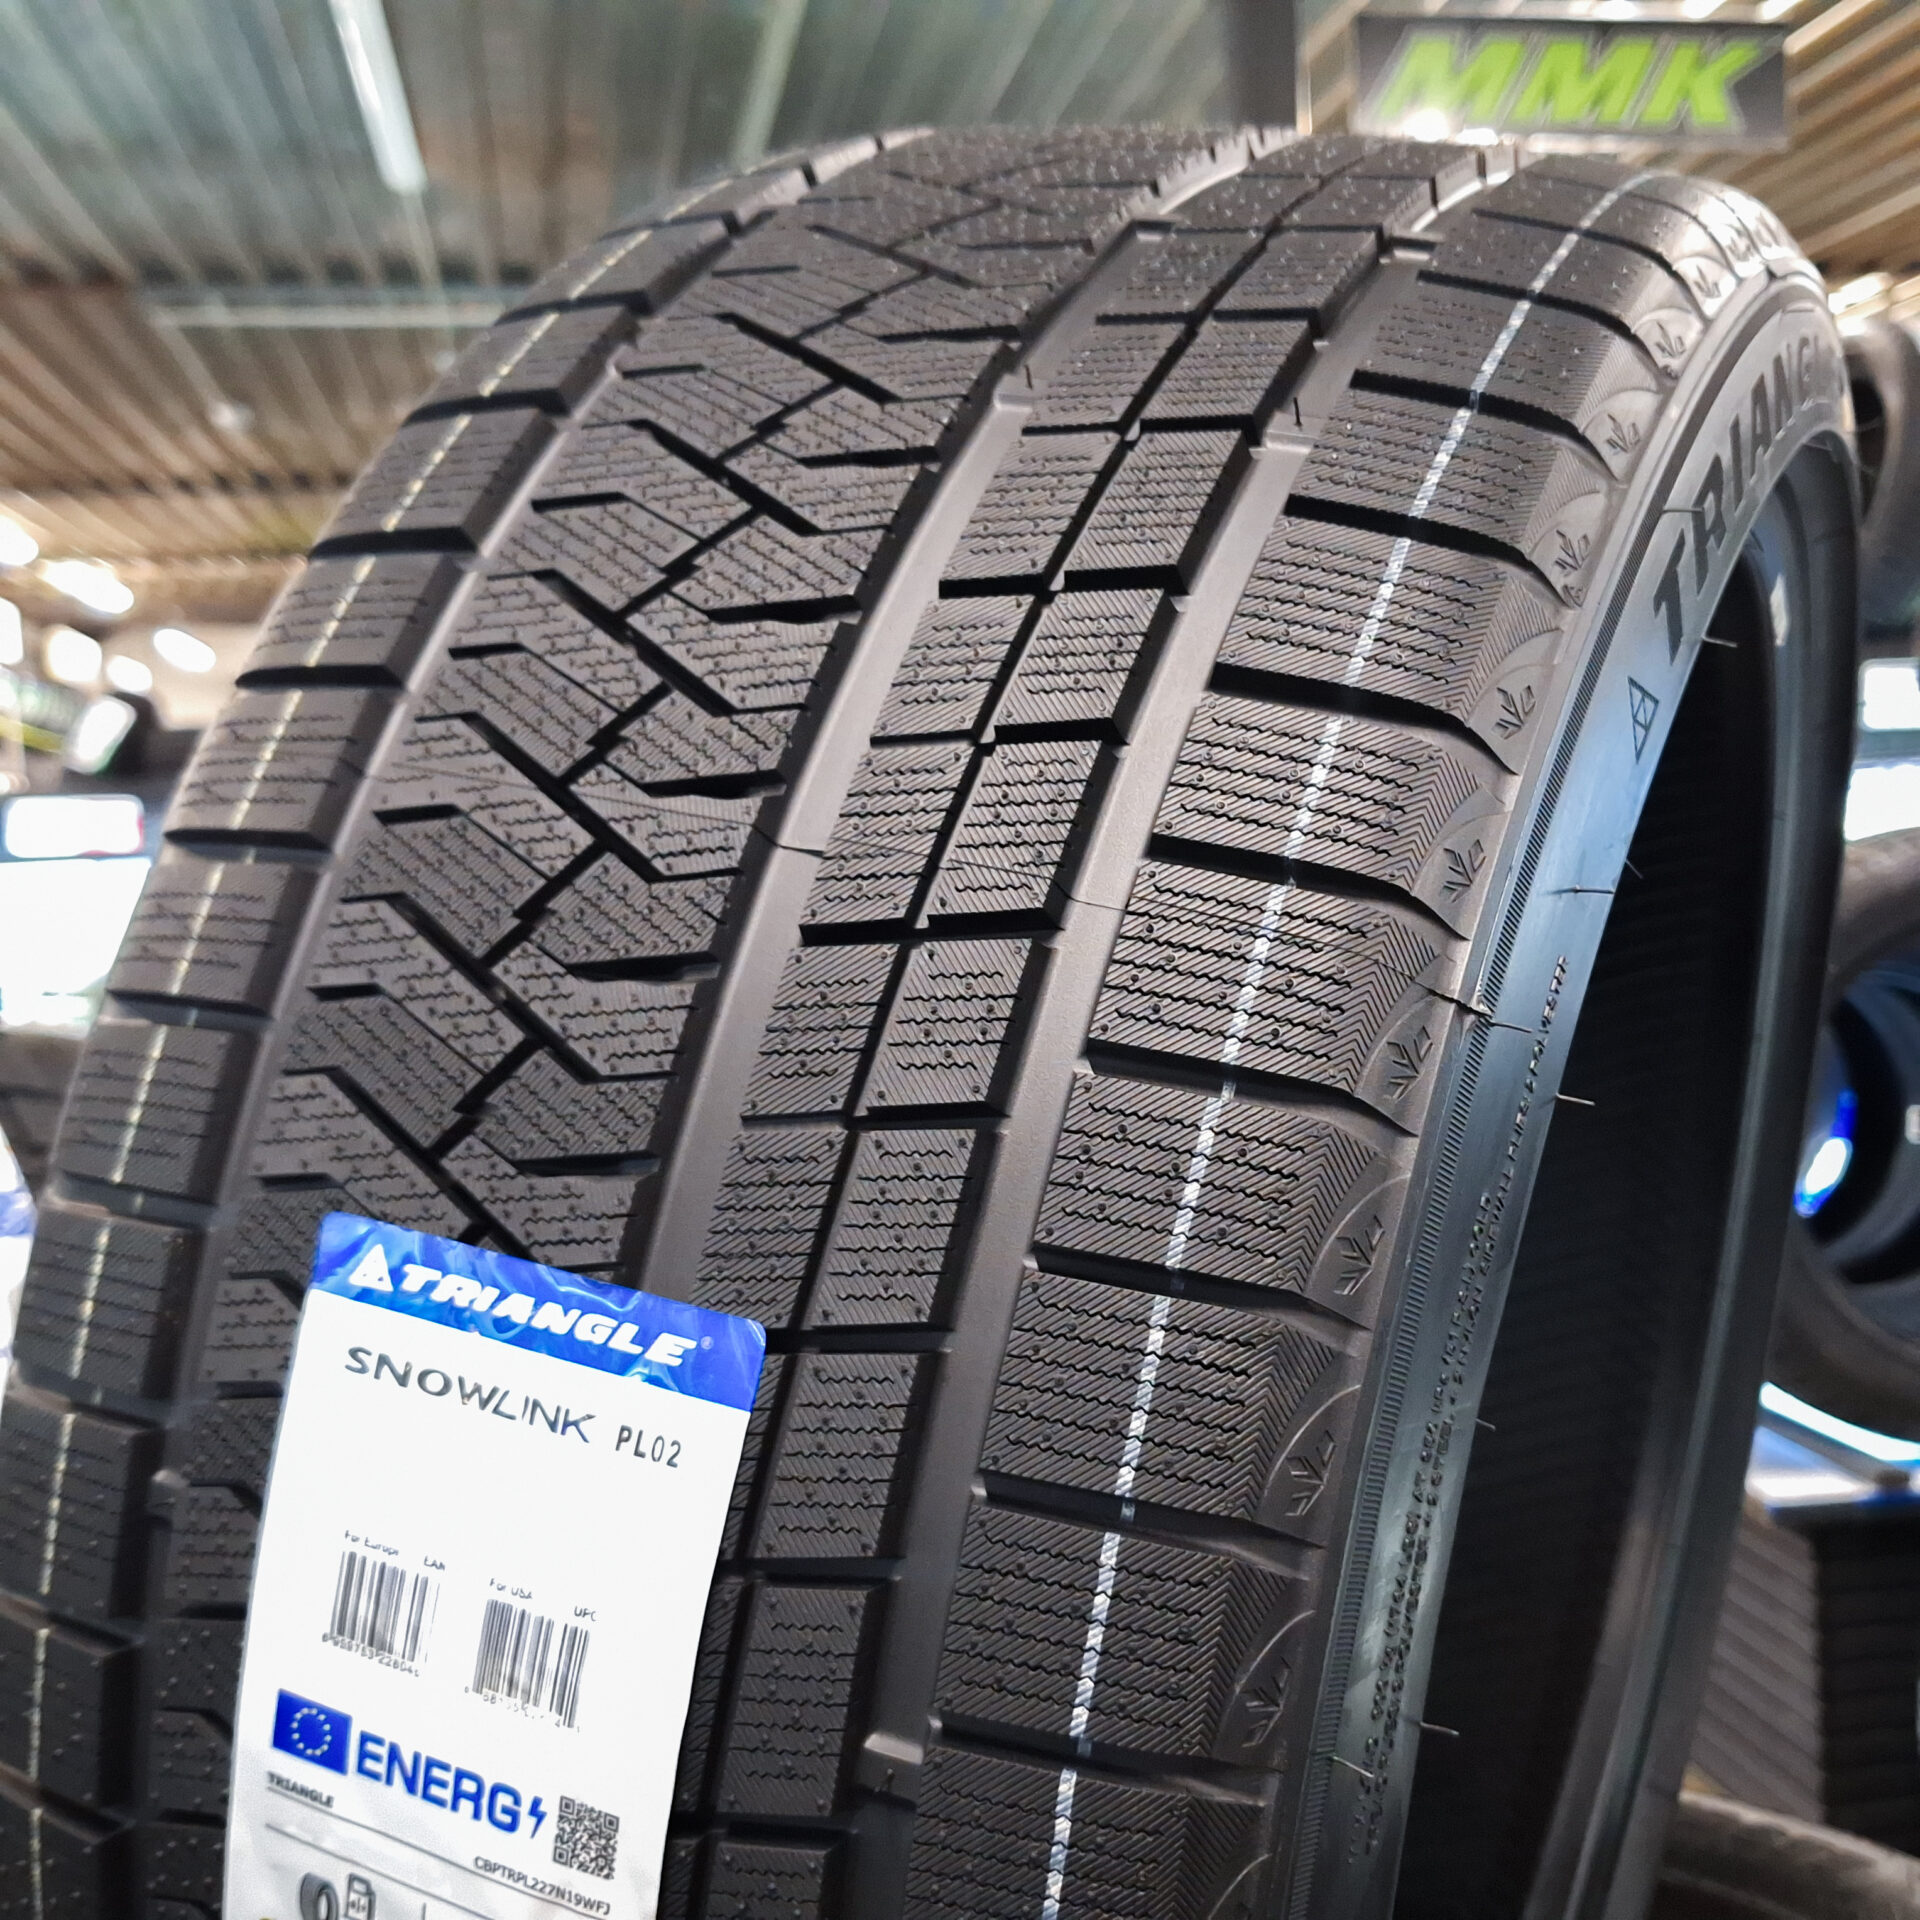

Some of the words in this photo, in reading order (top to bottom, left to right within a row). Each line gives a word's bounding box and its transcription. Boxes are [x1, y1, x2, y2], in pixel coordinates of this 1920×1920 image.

[1378, 36, 1760, 127] MMK
[400, 1262, 698, 1366] TRIANGLE
[344, 1345, 597, 1444] SNOWLINK
[615, 1424, 682, 1469] PL02
[266, 1770, 335, 1809] TRIANGLE
[356, 1729, 522, 1834] ENERG
